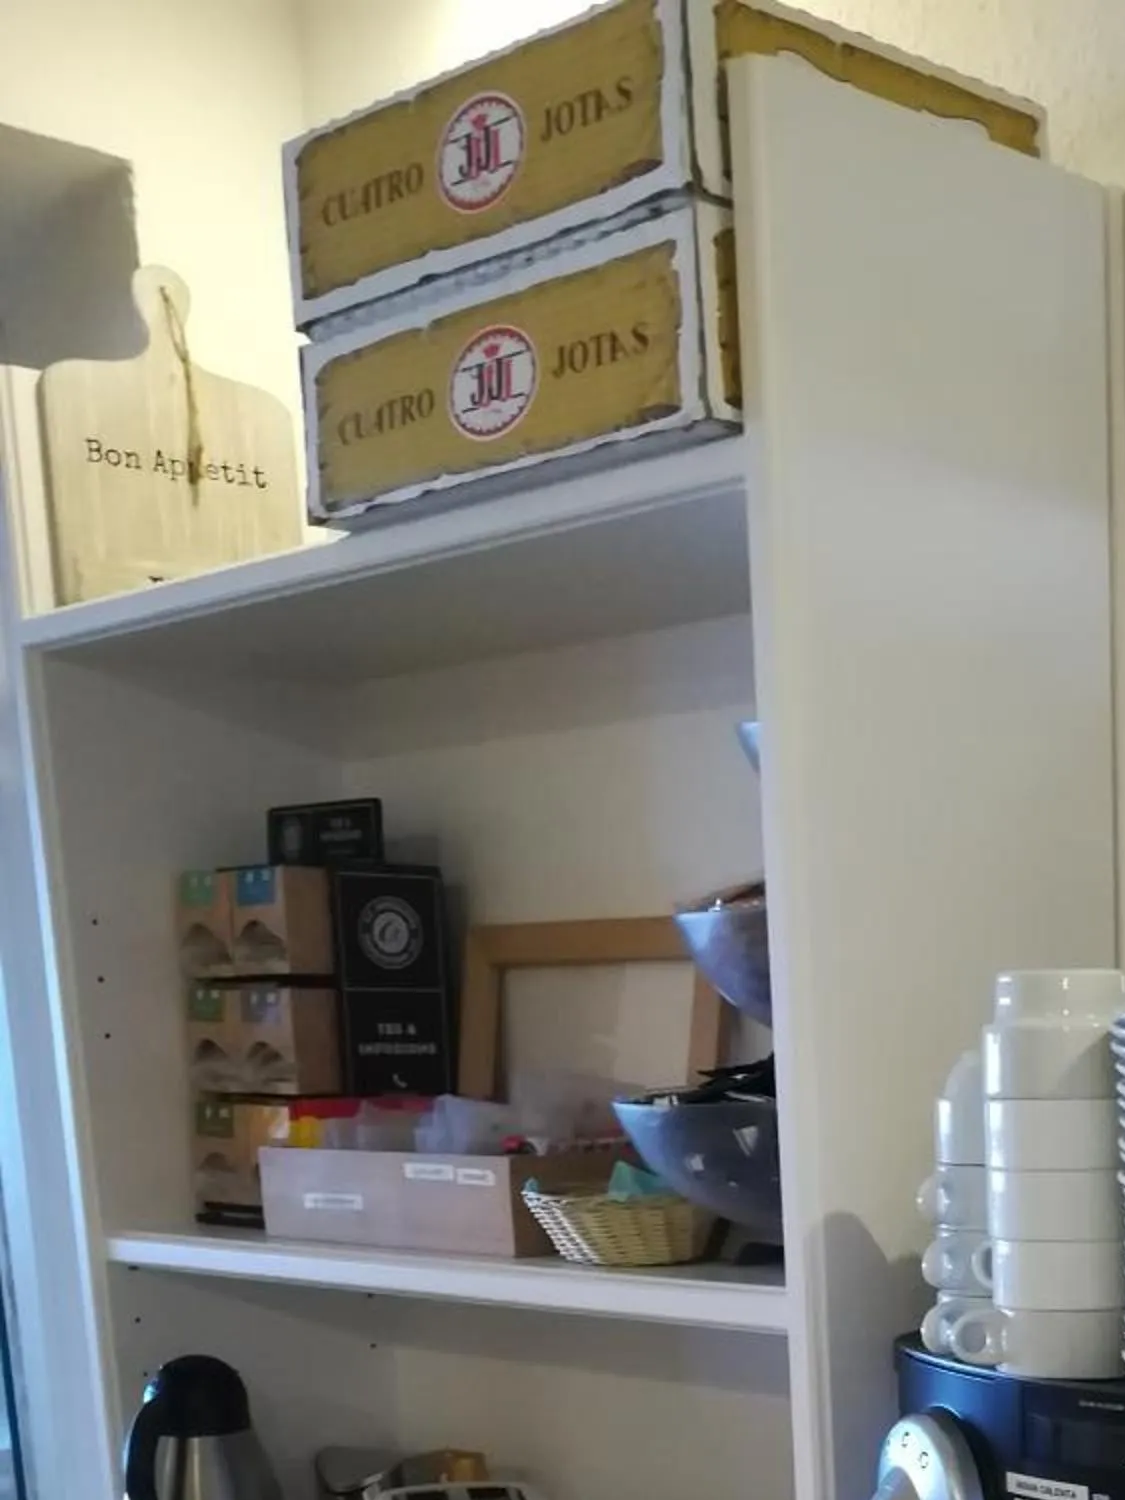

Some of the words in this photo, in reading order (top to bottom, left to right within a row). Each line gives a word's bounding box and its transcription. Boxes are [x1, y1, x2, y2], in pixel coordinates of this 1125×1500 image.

[320, 163, 424, 227] CUATRO
[540, 75, 635, 142] JOTAS
[337, 387, 434, 446] CUATRO
[552, 321, 652, 379] JOTAS
[85, 438, 142, 470] Bon
[153, 450, 267, 489] Apetit
